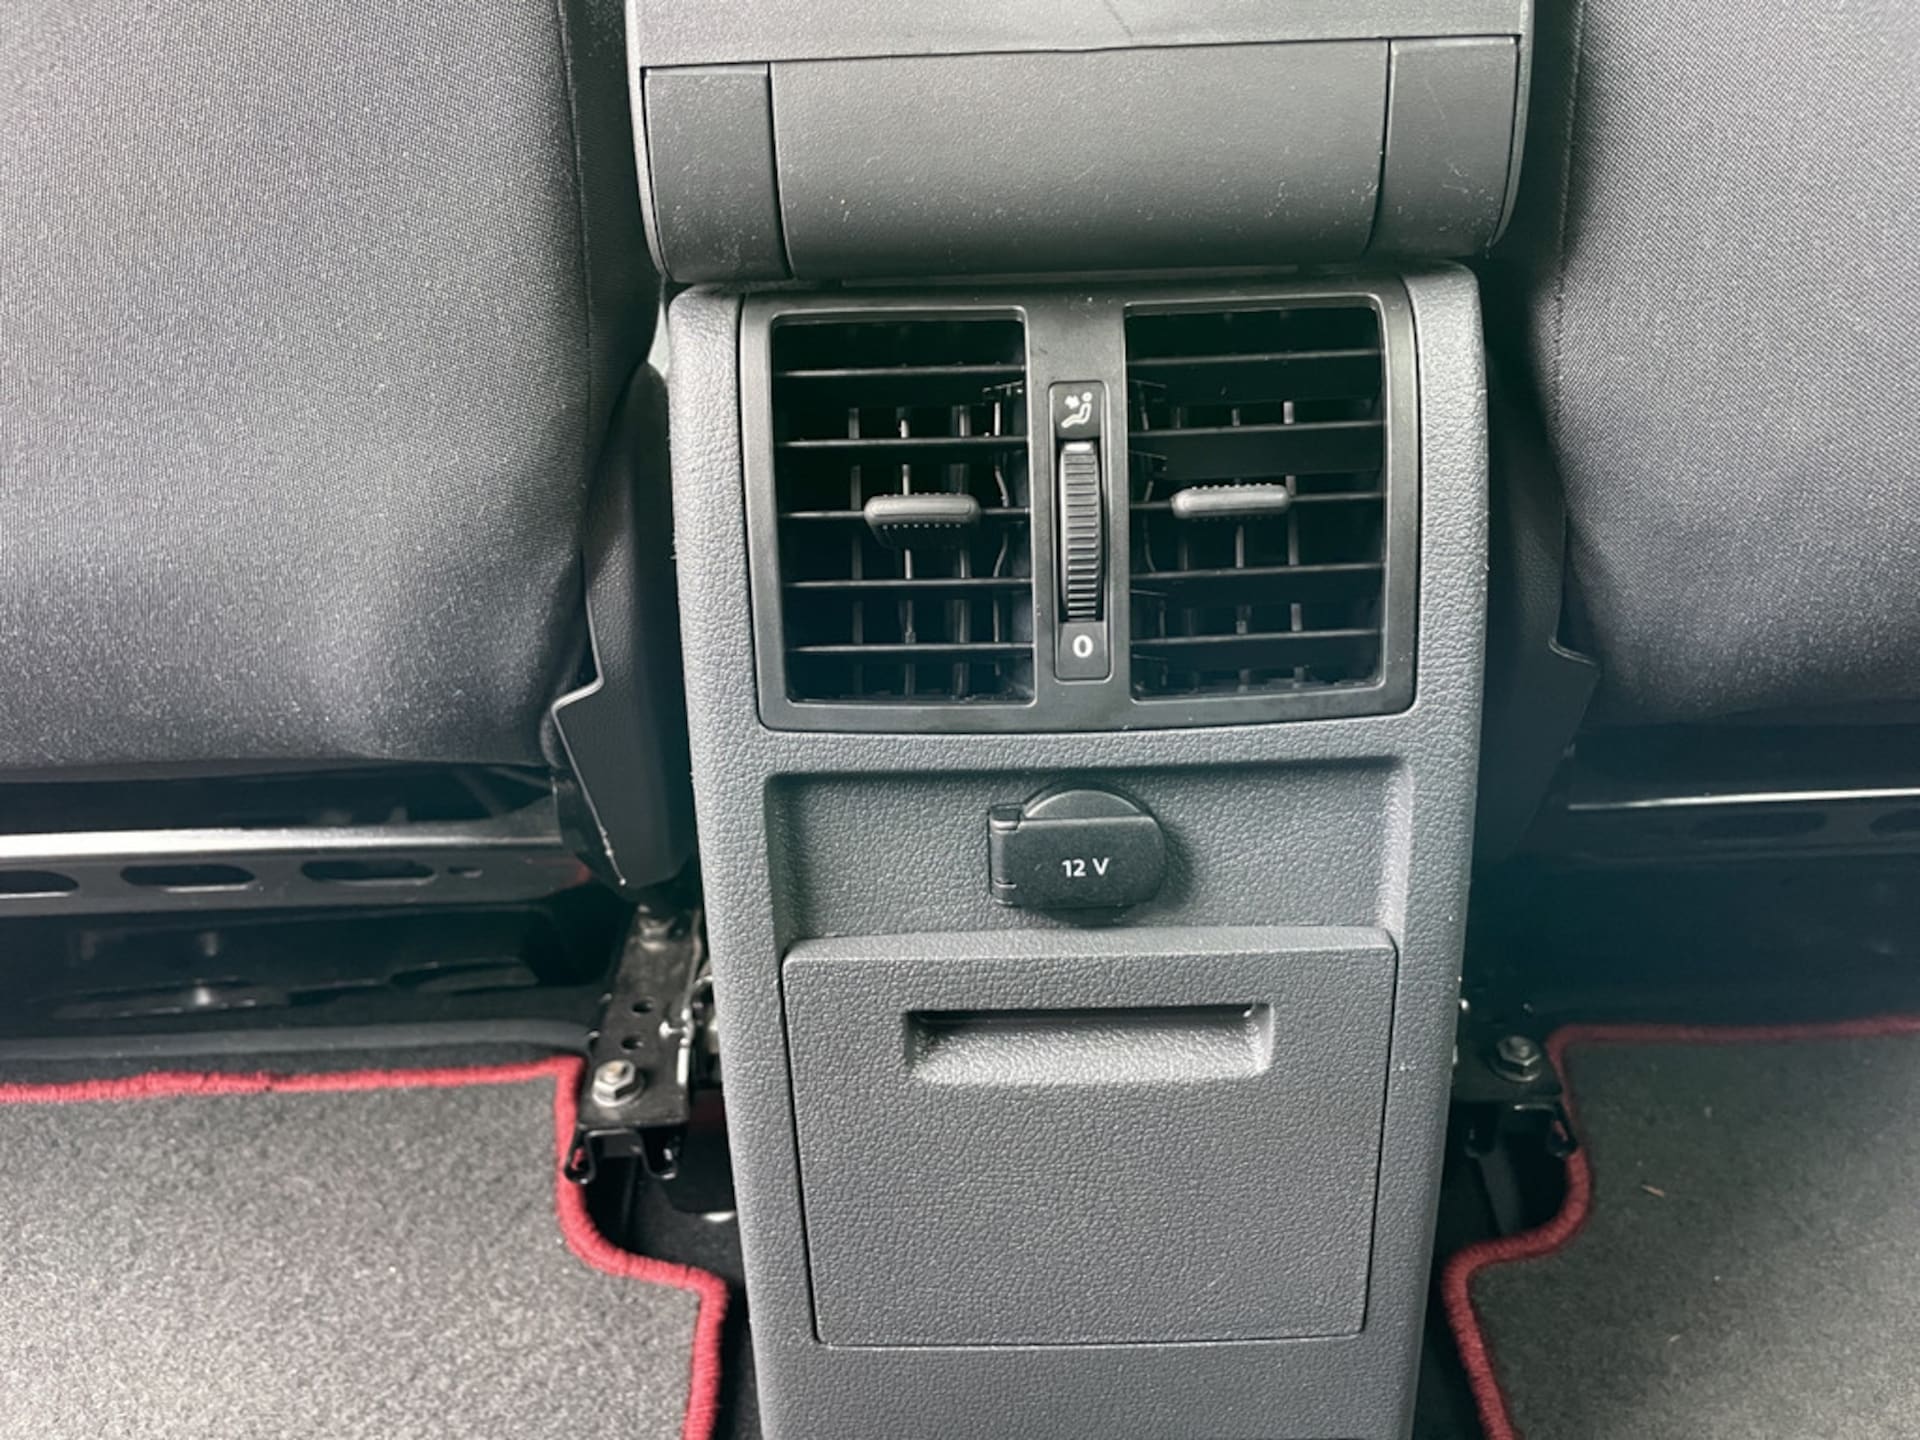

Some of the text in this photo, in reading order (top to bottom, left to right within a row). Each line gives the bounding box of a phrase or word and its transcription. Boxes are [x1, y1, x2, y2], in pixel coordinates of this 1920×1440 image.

[1073, 635, 1093, 658] 0
[1061, 857, 1110, 877] 12 V
